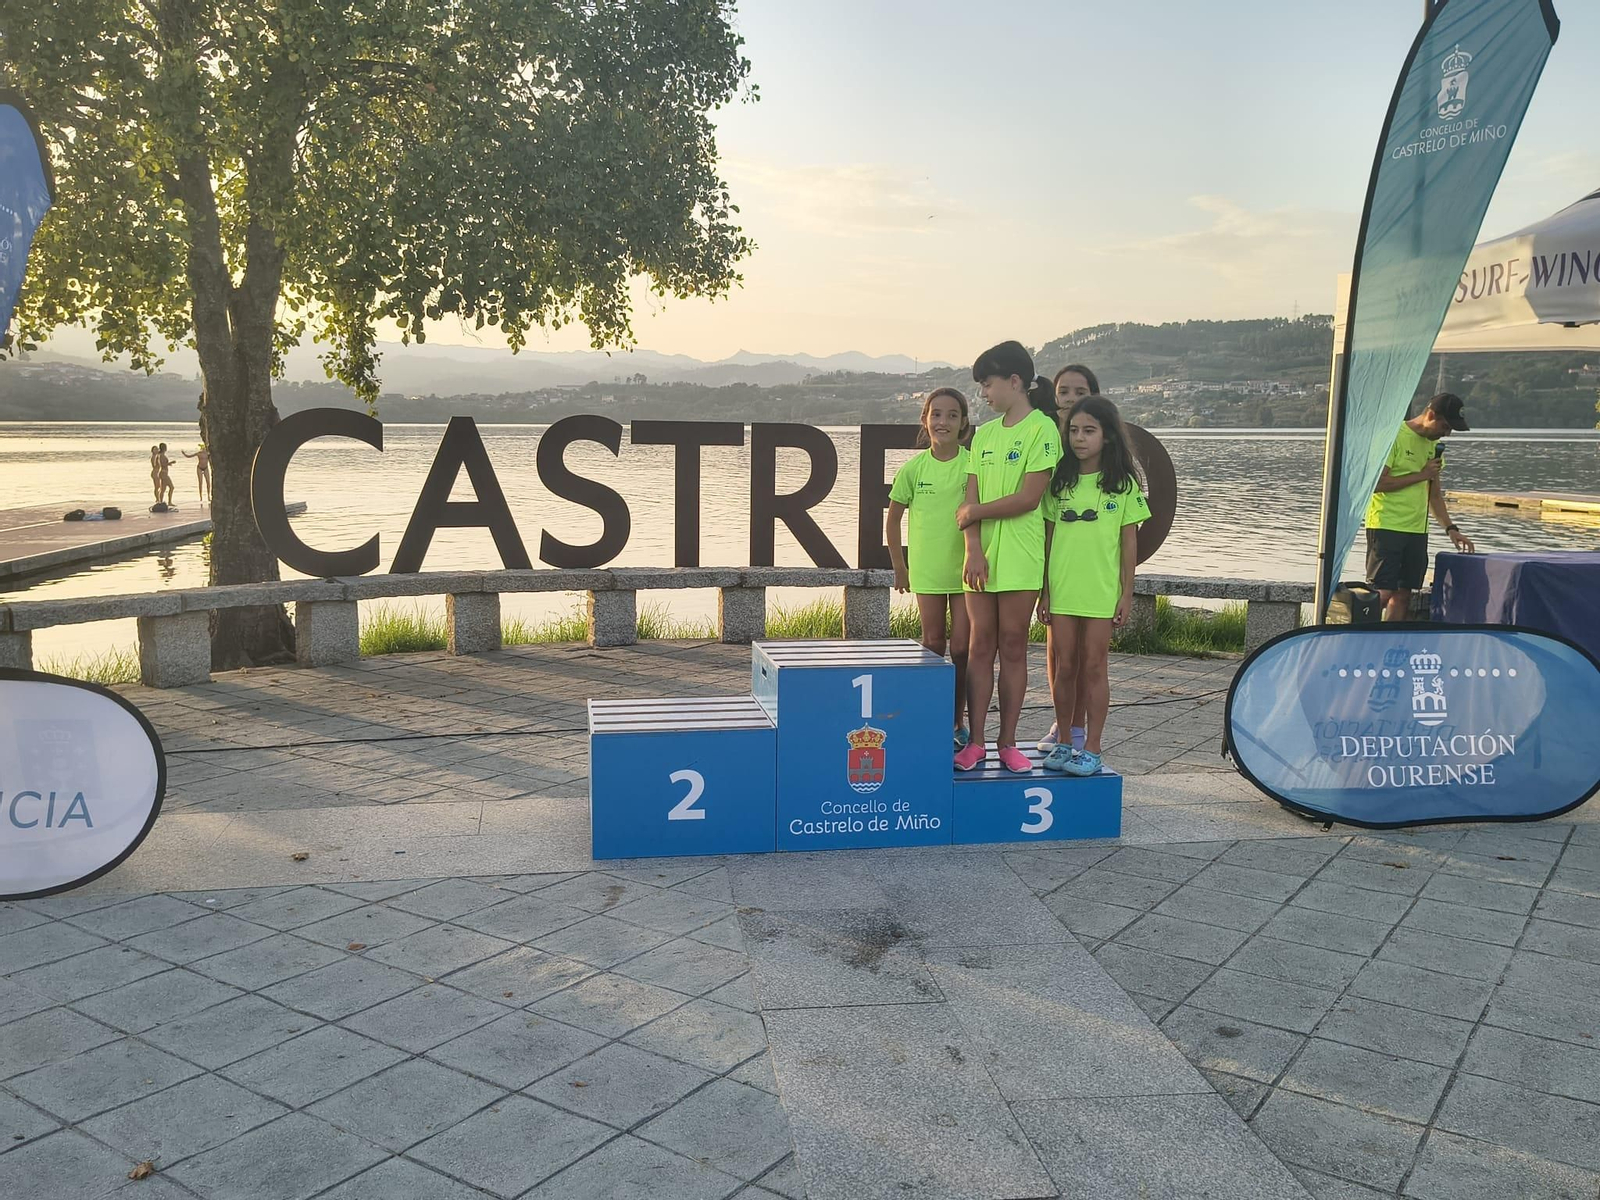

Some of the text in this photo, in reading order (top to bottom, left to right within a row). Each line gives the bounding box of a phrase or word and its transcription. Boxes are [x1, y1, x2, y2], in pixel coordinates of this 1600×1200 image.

[1392, 124, 1507, 159] CASTRELO DE MIÑO
[1420, 118, 1479, 139] CONCELLO DE
[250, 408, 1178, 577] CASTRE
[851, 674, 874, 719] 1
[1339, 728, 1516, 758] DEPUTACIÓN
[1367, 763, 1496, 788] OURENSE
[0, 790, 94, 829] CIA
[667, 769, 706, 821] 2
[820, 798, 910, 815] Concello de
[1020, 787, 1054, 834] 3
[789, 814, 941, 835] Castrelo de Miño
